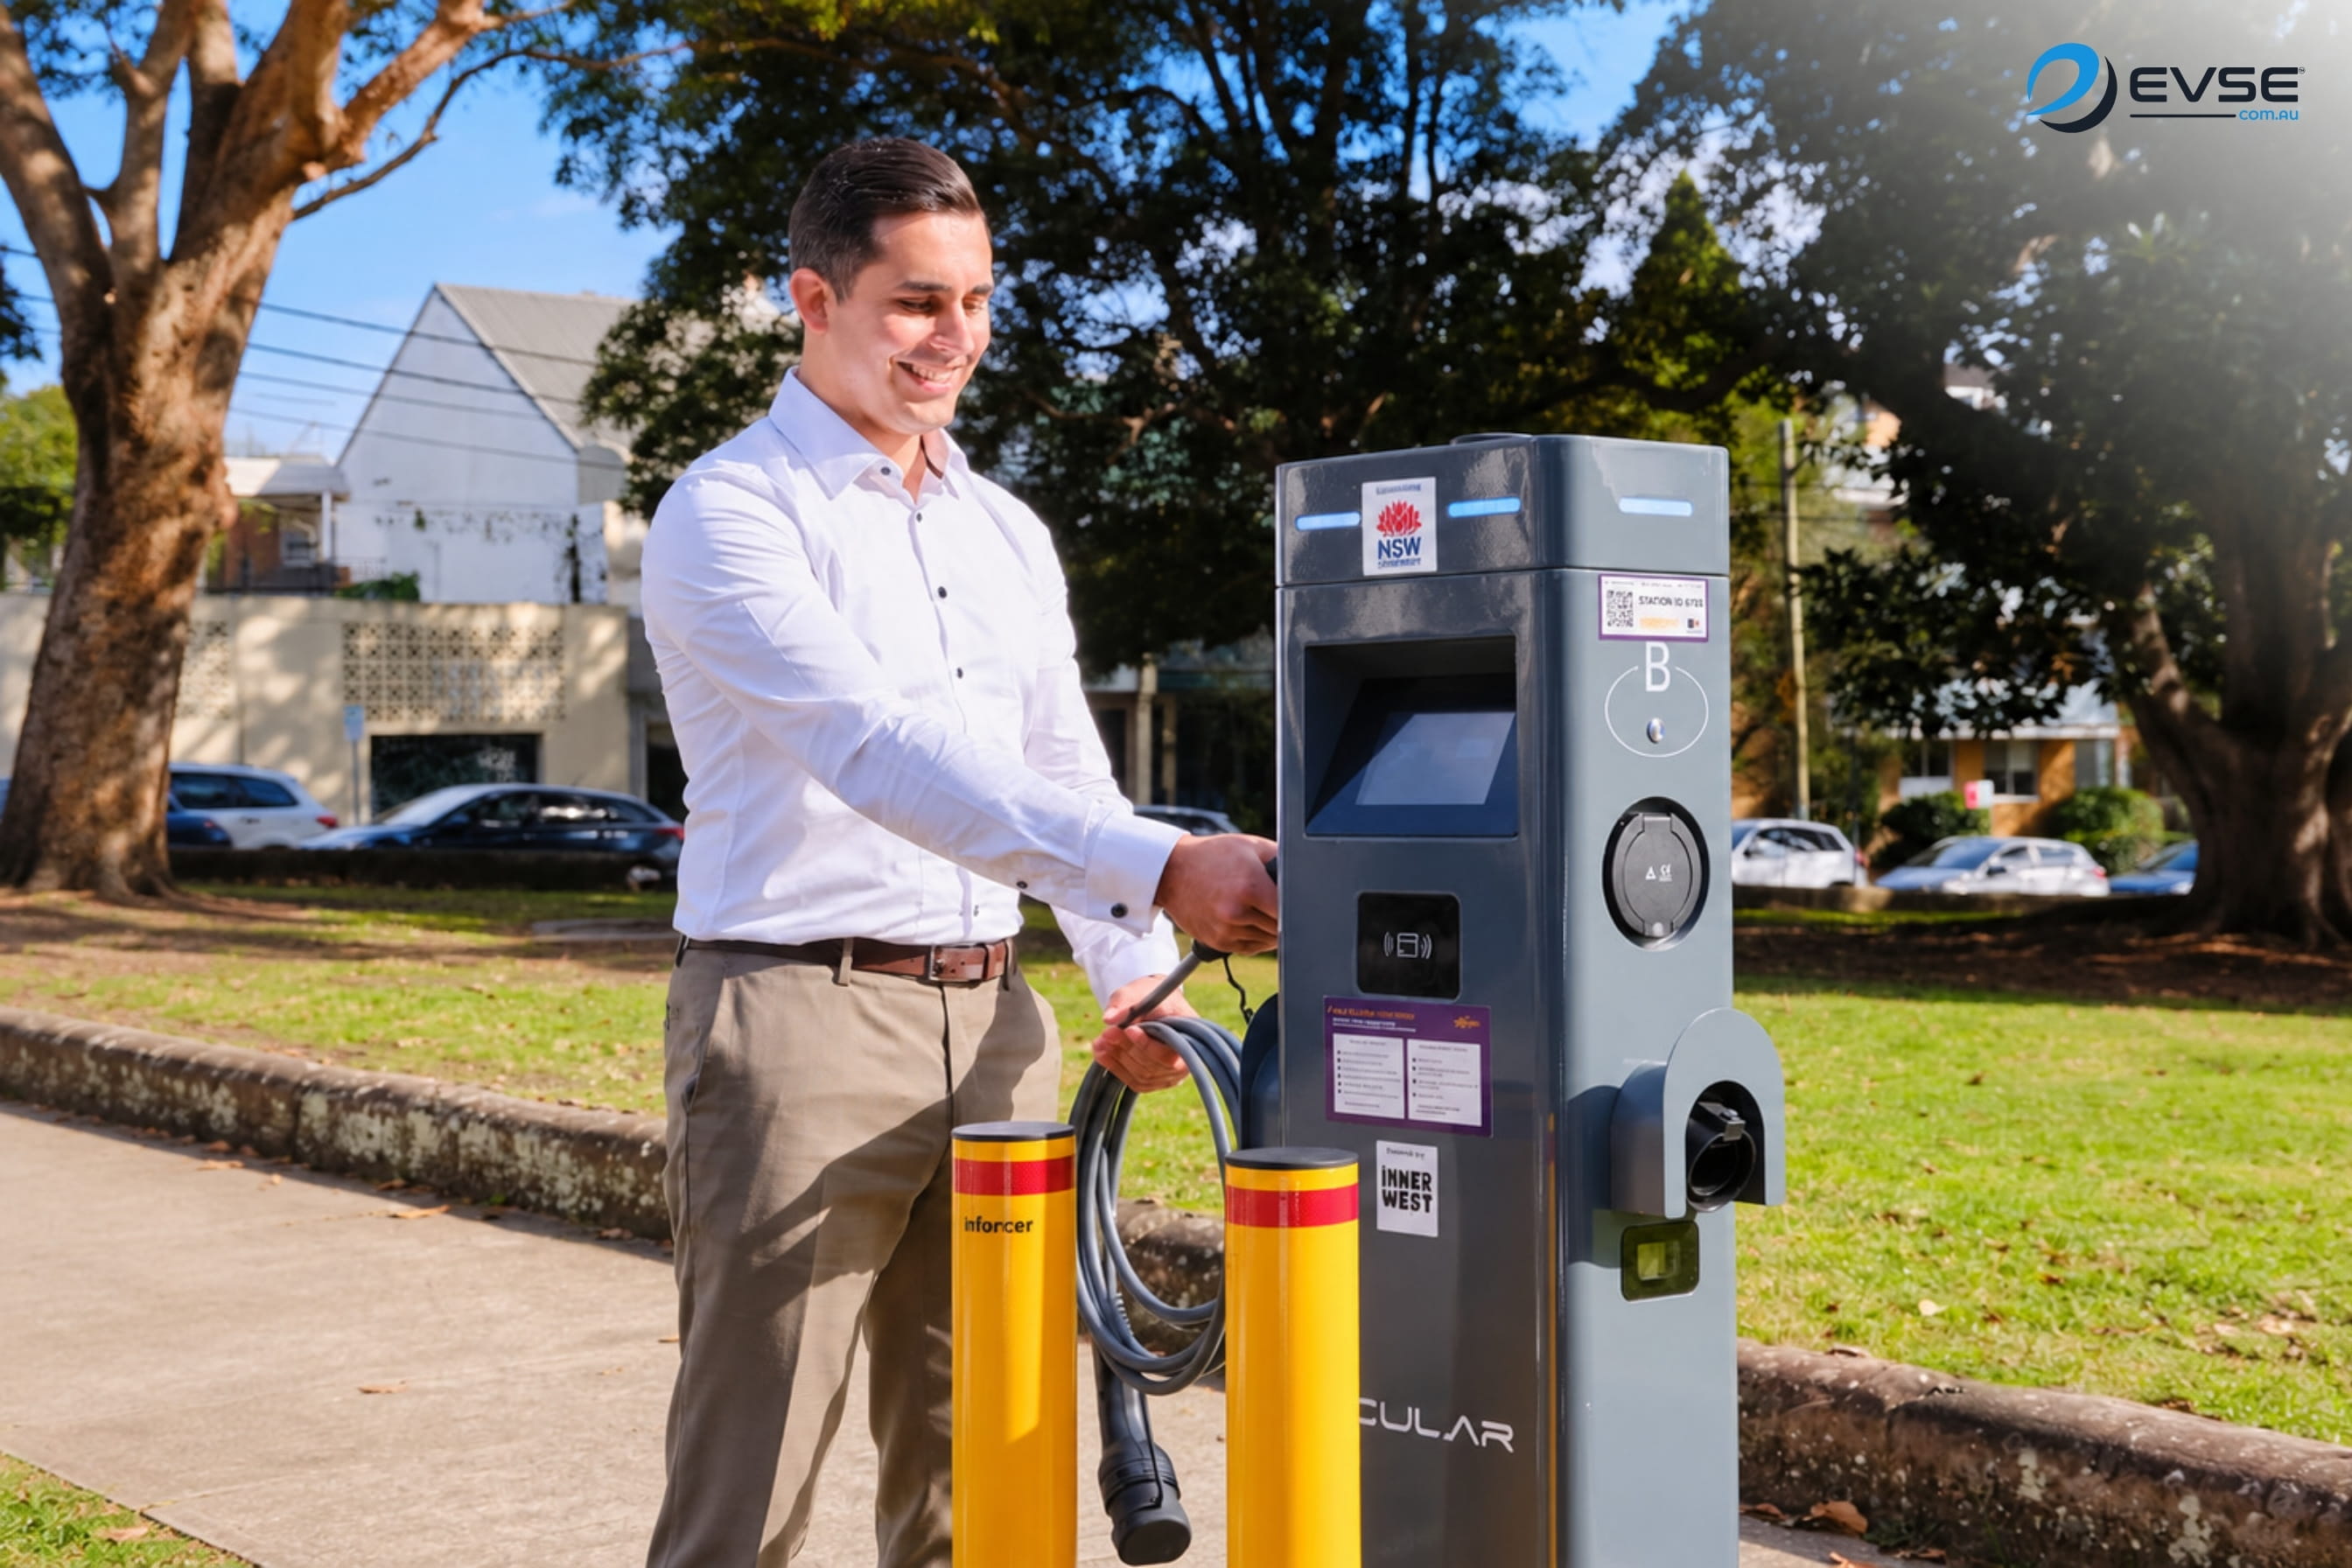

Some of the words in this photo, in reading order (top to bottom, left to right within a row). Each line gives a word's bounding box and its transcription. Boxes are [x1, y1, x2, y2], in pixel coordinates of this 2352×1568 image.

[1377, 536, 1422, 560] NSW
[1638, 595, 1673, 606] STATION
[1645, 640, 1671, 692] B
[1382, 1189, 1432, 1214] WEST
[964, 1215, 1033, 1233] inforcer
